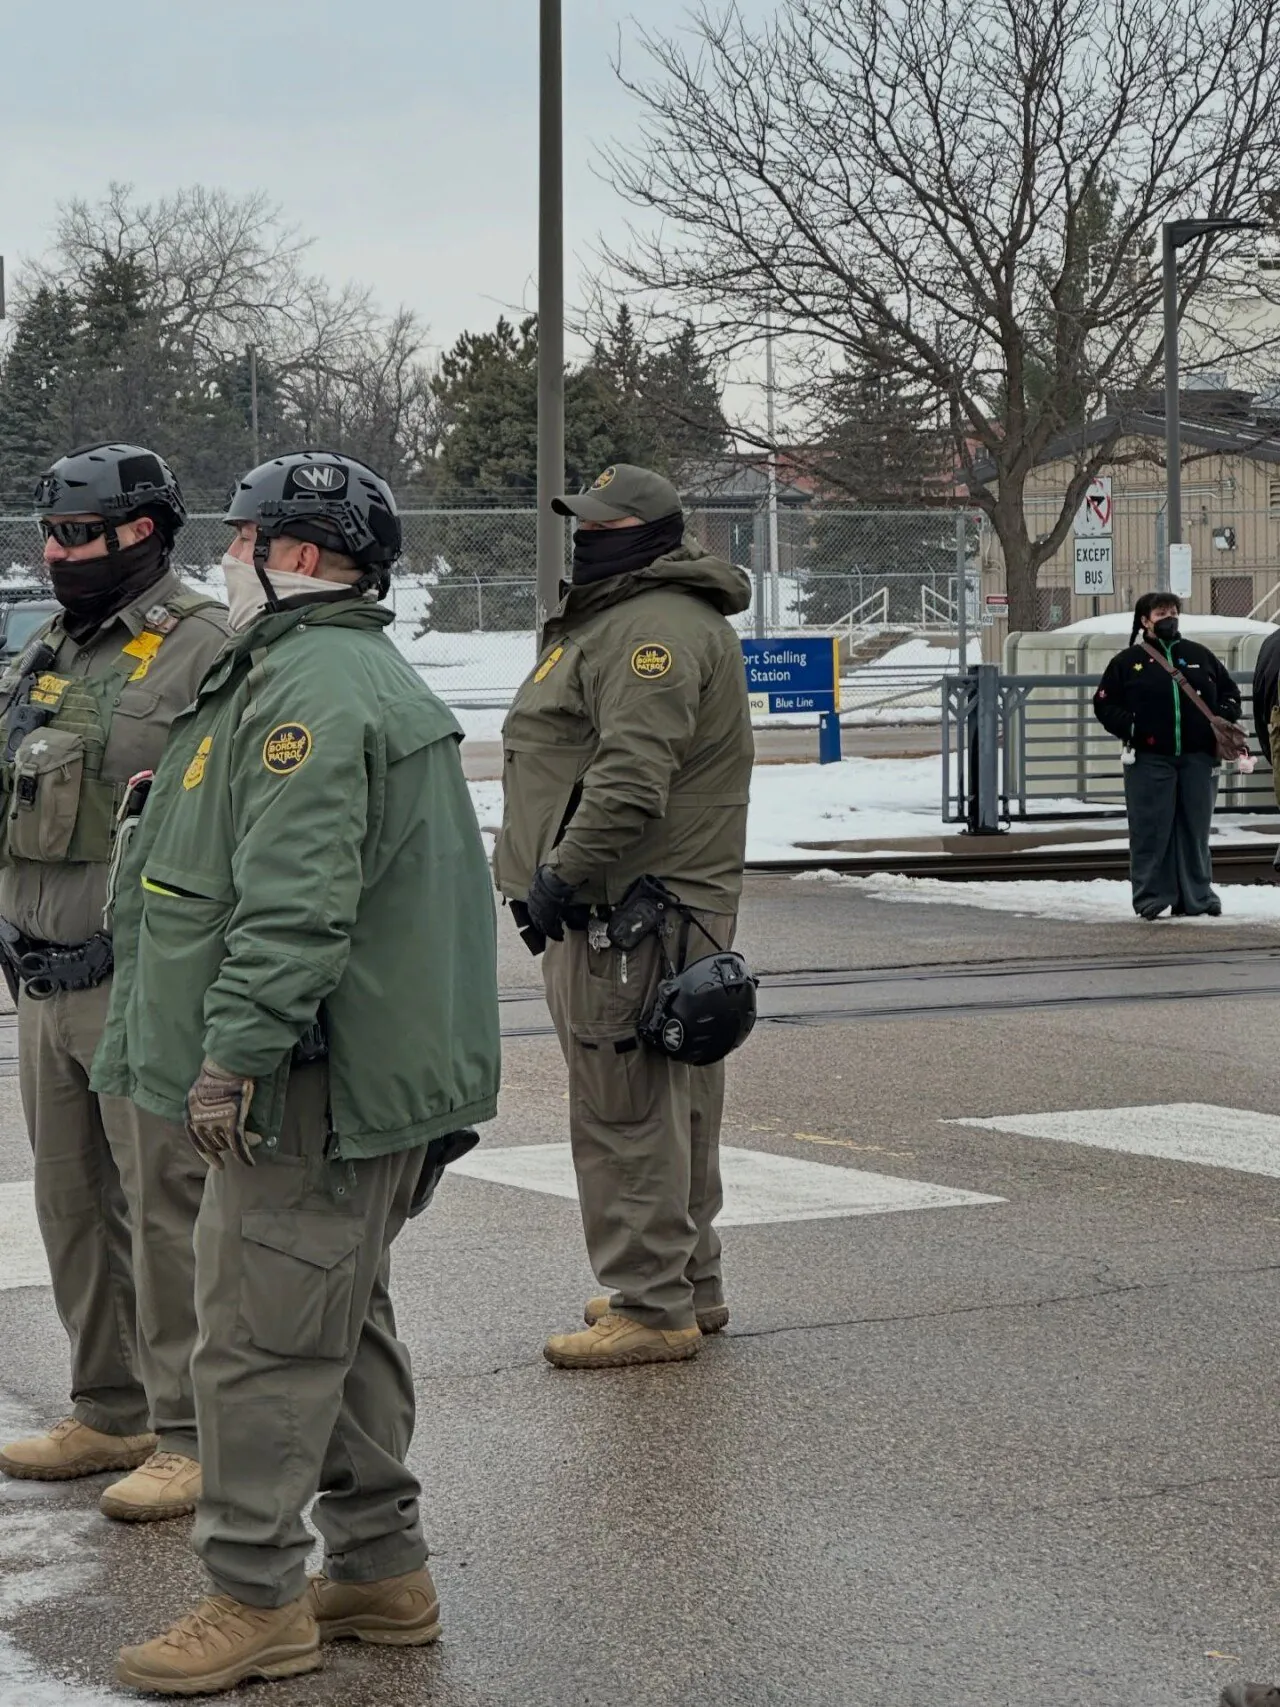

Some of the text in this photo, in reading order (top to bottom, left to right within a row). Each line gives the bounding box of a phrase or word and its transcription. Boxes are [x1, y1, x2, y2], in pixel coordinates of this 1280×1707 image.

[1077, 548, 1110, 561] EXCEPT
[1085, 571, 1102, 584] BUS
[743, 651, 807, 667] ort Snelling
[637, 663, 665, 671] PATROL
[751, 669, 791, 682] Station
[776, 697, 814, 708] Blue Line
[281, 732, 296, 741] U.S.
[269, 739, 304, 752] BORDER
[269, 750, 302, 761] PATROL
